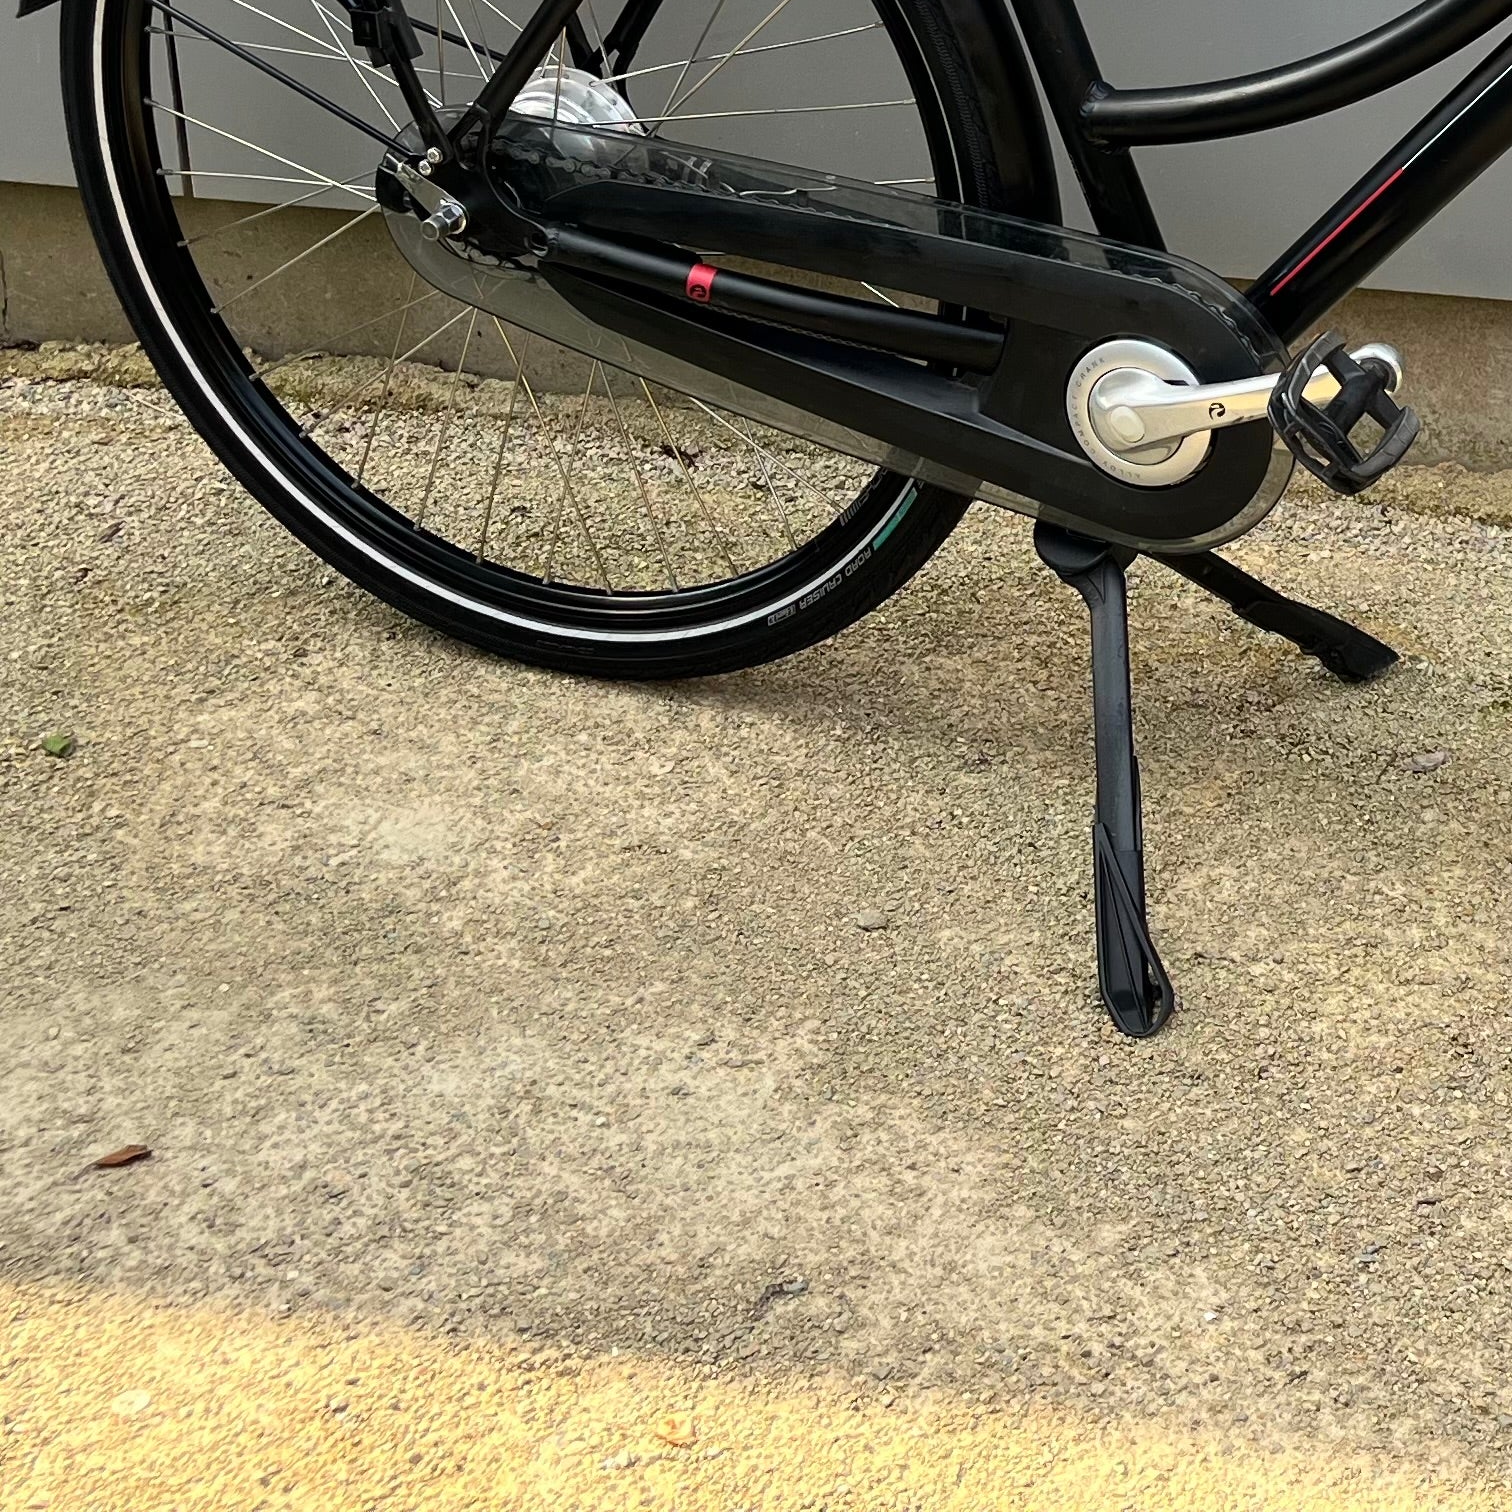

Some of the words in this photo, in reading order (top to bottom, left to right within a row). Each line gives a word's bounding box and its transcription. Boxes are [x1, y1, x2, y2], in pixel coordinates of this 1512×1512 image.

[1076, 357, 1106, 388] CRANK
[844, 548, 873, 578] ROAD
[798, 577, 844, 610] CRUISER
